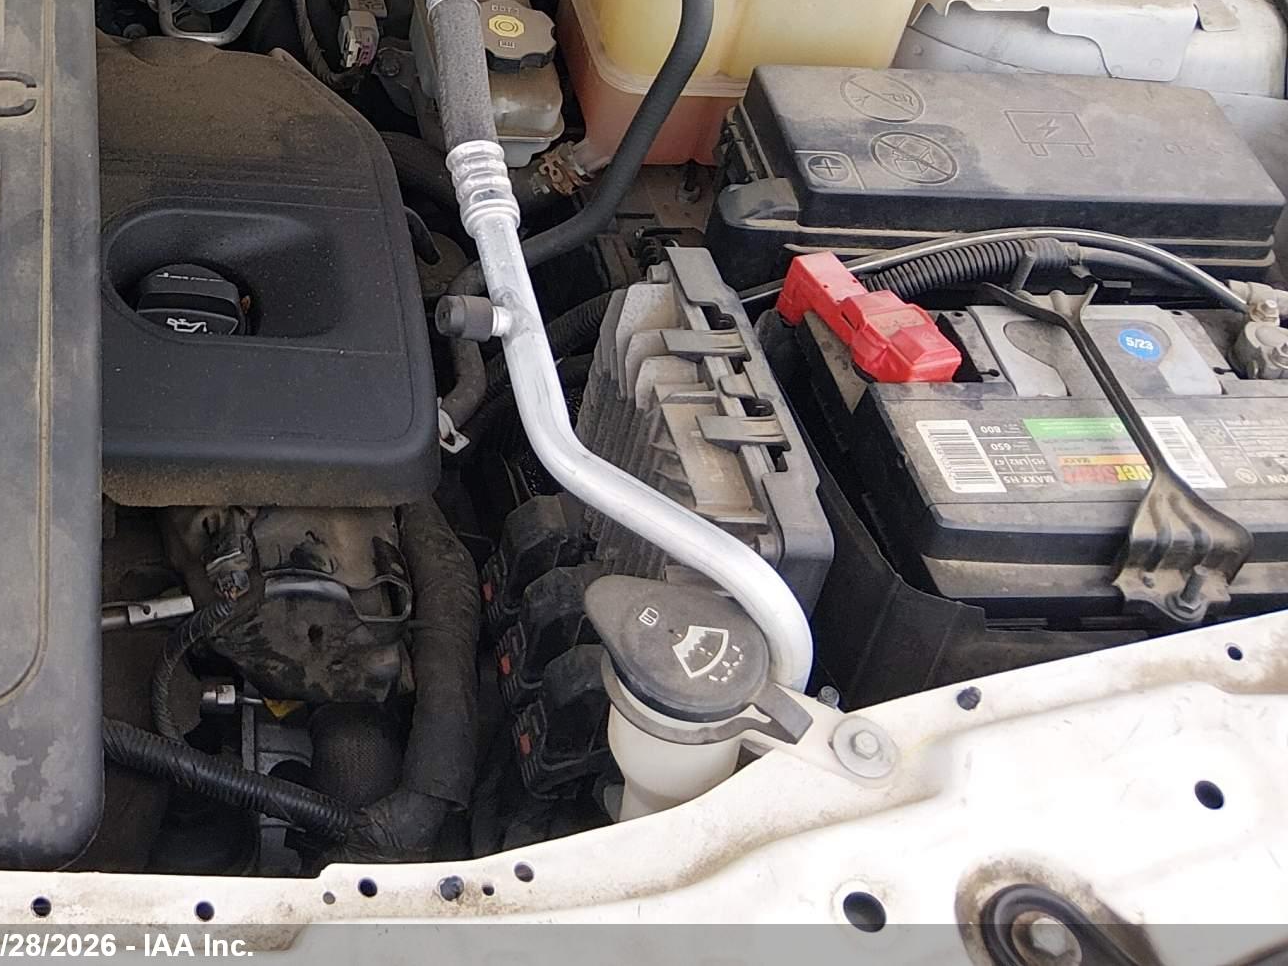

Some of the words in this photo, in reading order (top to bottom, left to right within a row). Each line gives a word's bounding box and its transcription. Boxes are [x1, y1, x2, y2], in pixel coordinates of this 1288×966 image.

[1125, 337, 1154, 351] 5/23
[980, 425, 1002, 434] 800
[990, 442, 1012, 451] 650
[1020, 475, 1057, 484] MAXX
[1062, 465, 1152, 485] verStart
